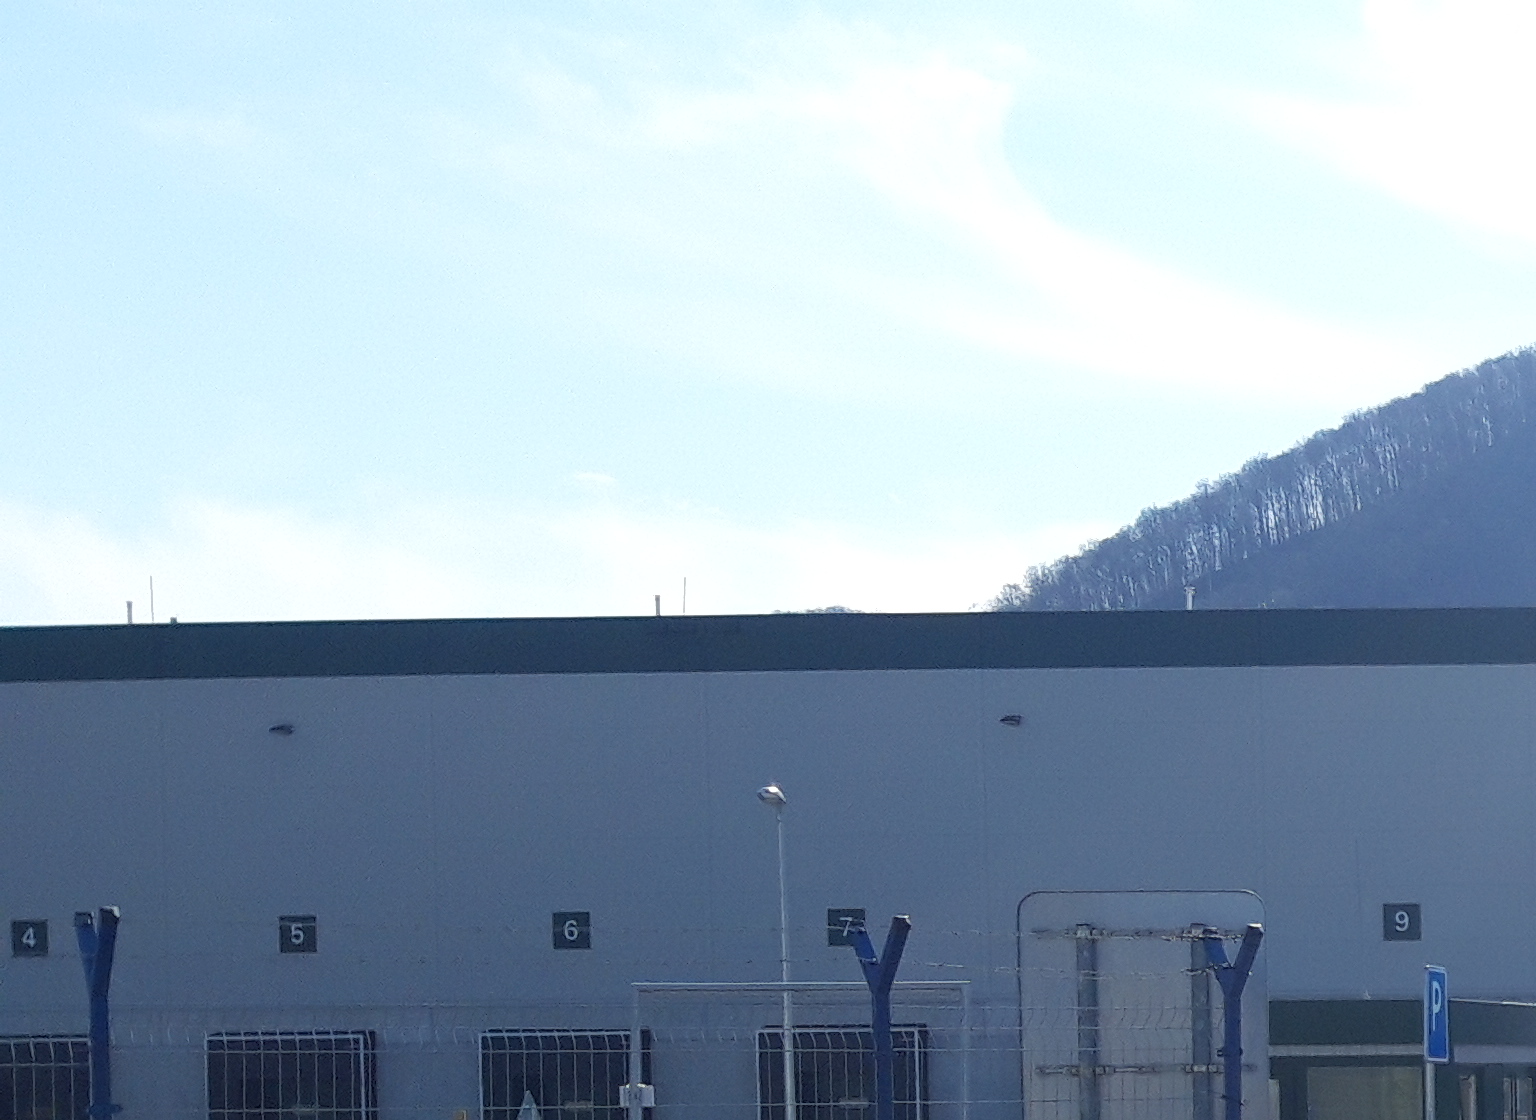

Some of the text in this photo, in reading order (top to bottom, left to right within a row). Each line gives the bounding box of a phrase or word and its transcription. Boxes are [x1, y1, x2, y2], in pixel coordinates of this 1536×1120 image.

[563, 919, 579, 941] 6
[1394, 910, 1410, 932] 9
[20, 926, 37, 948] 4
[290, 923, 304, 945] 5
[1431, 980, 1442, 1032] P
